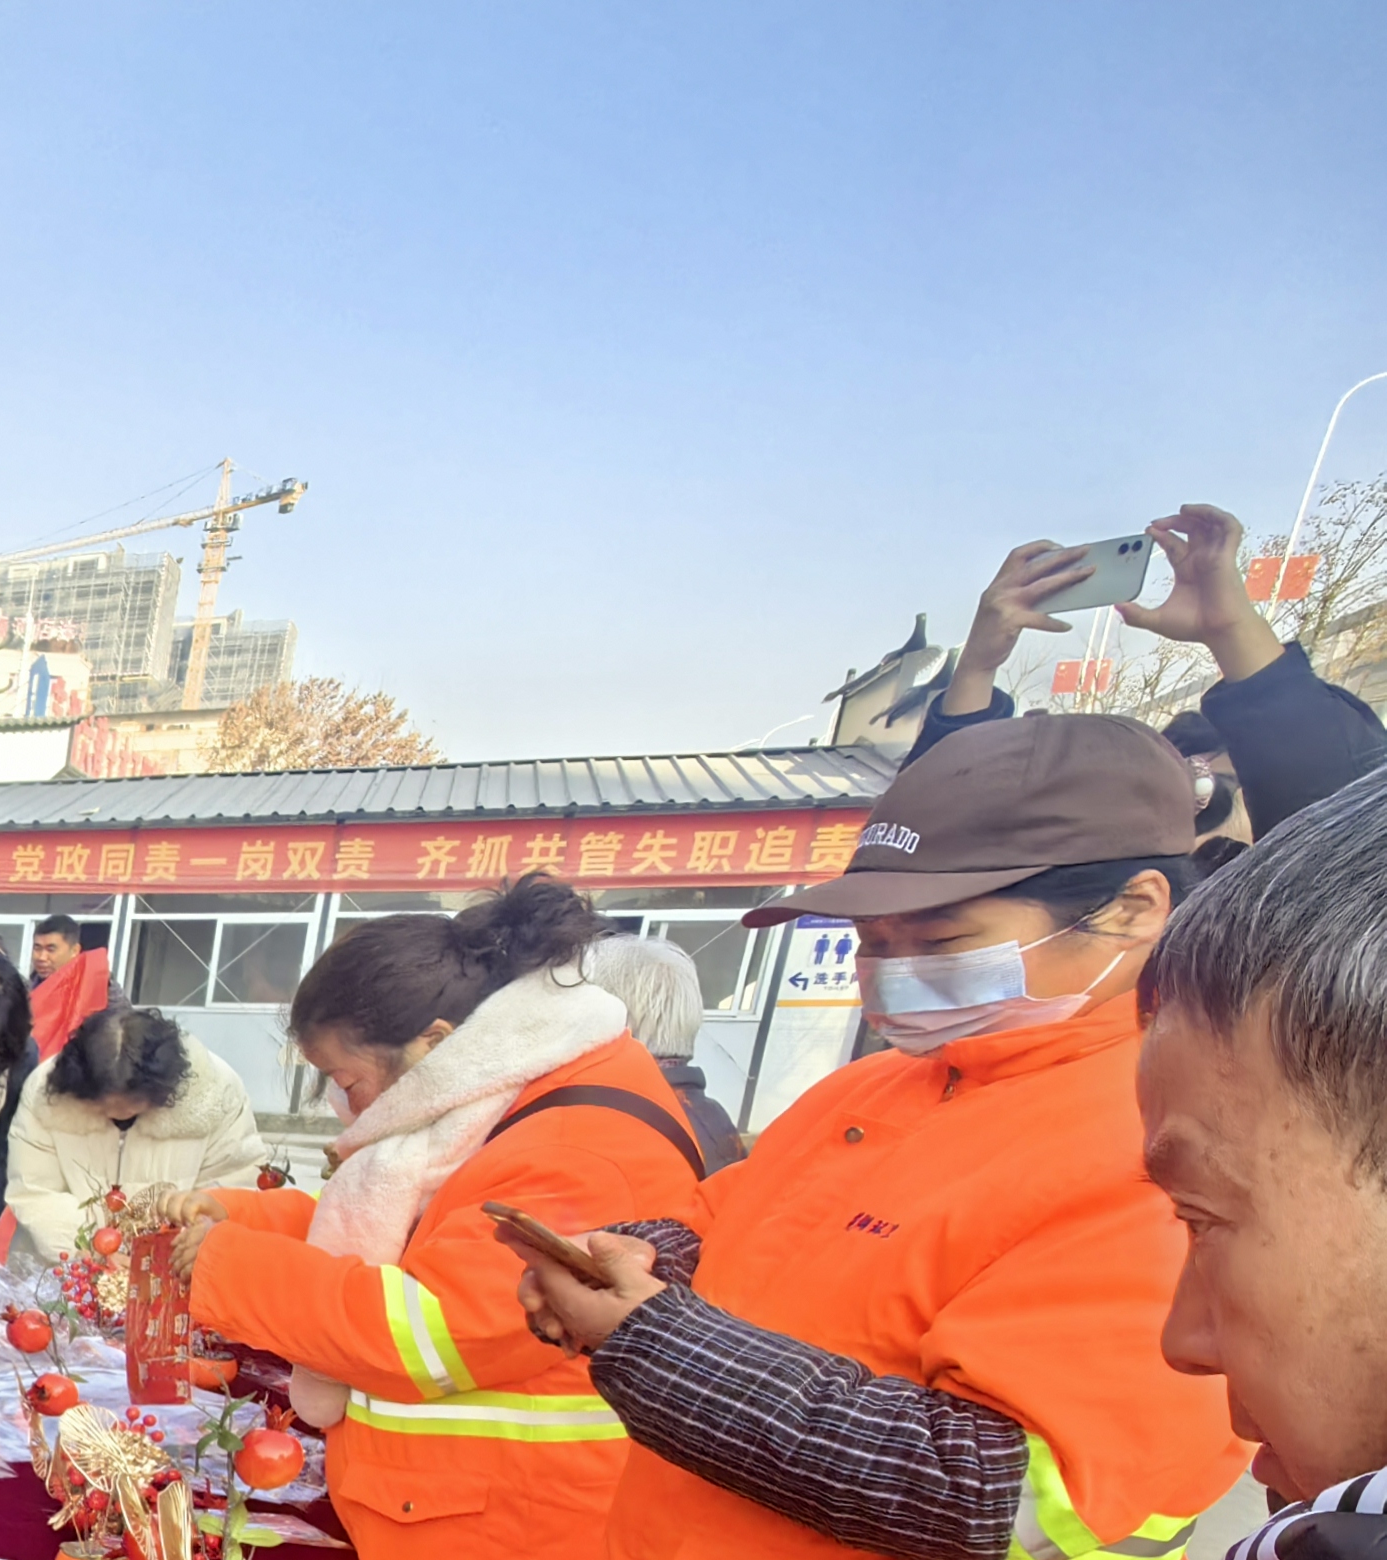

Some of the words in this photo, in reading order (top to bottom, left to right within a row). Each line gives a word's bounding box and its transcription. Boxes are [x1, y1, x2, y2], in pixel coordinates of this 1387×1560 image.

[9, 838, 376, 883] 党政同责一岗双责
[416, 823, 859, 876] 齐抓共管失职追责
[858, 823, 920, 854] ORADO
